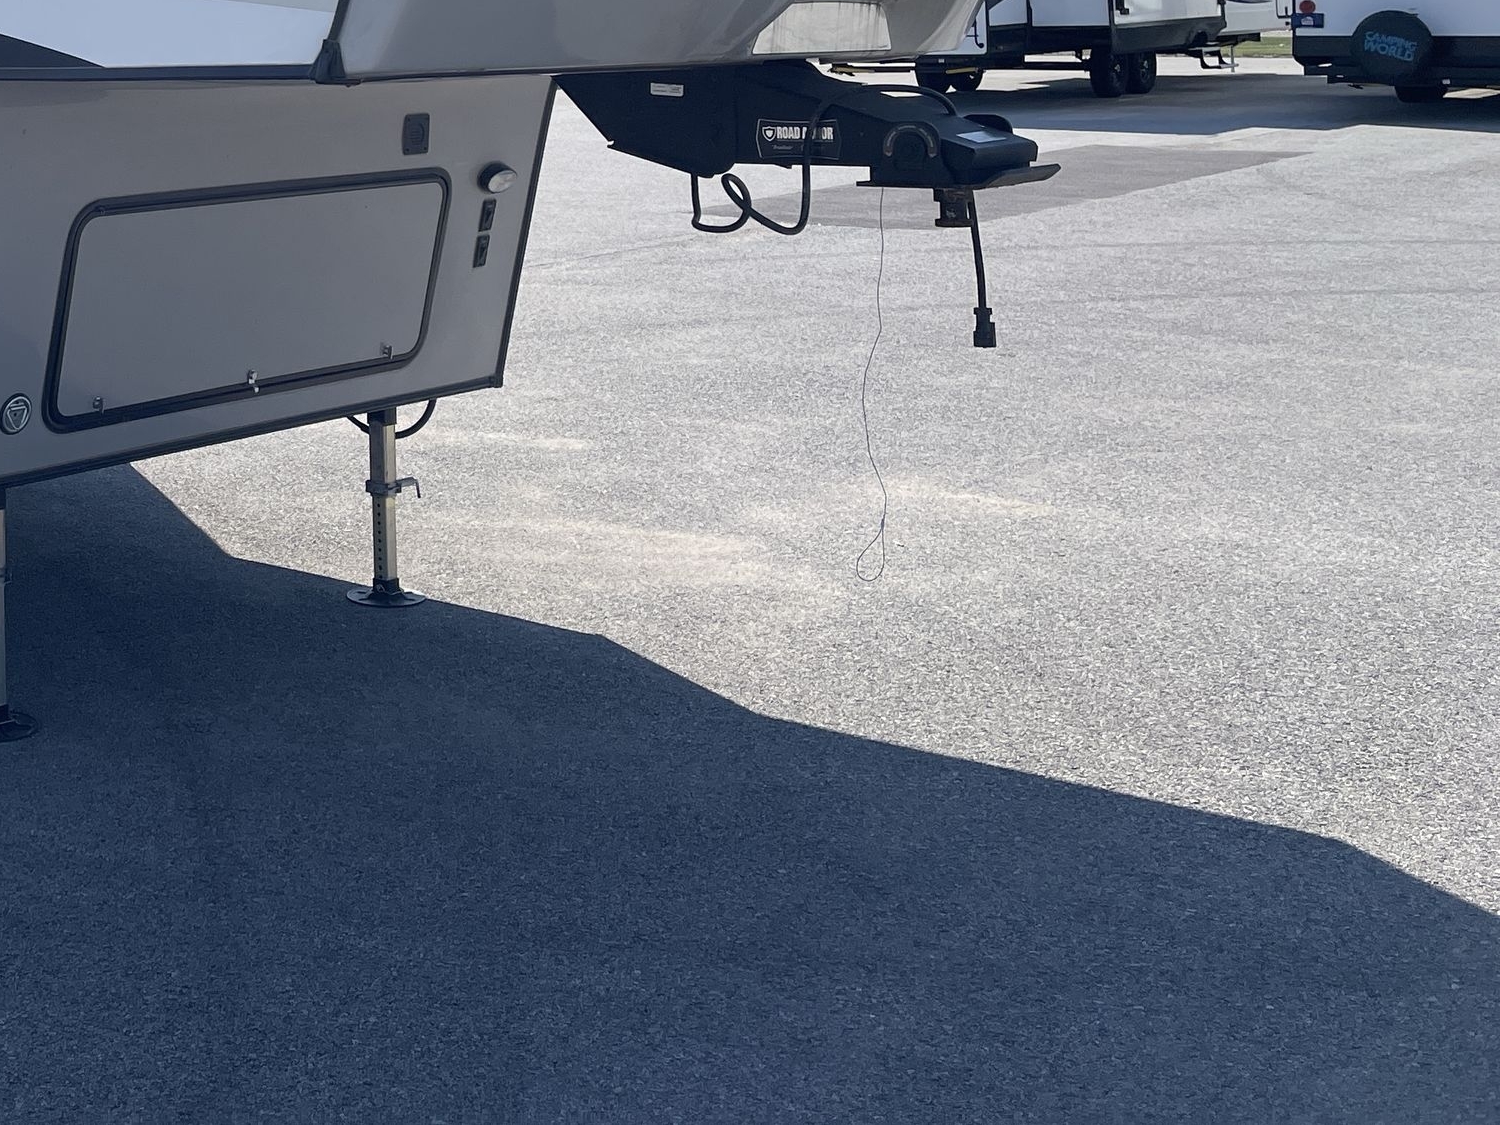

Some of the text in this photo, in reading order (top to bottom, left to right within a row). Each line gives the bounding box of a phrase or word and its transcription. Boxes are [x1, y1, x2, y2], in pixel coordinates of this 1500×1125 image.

[1364, 31, 1418, 52] CAMPING
[1364, 39, 1414, 62] WORLD
[776, 126, 801, 140] ROAD
